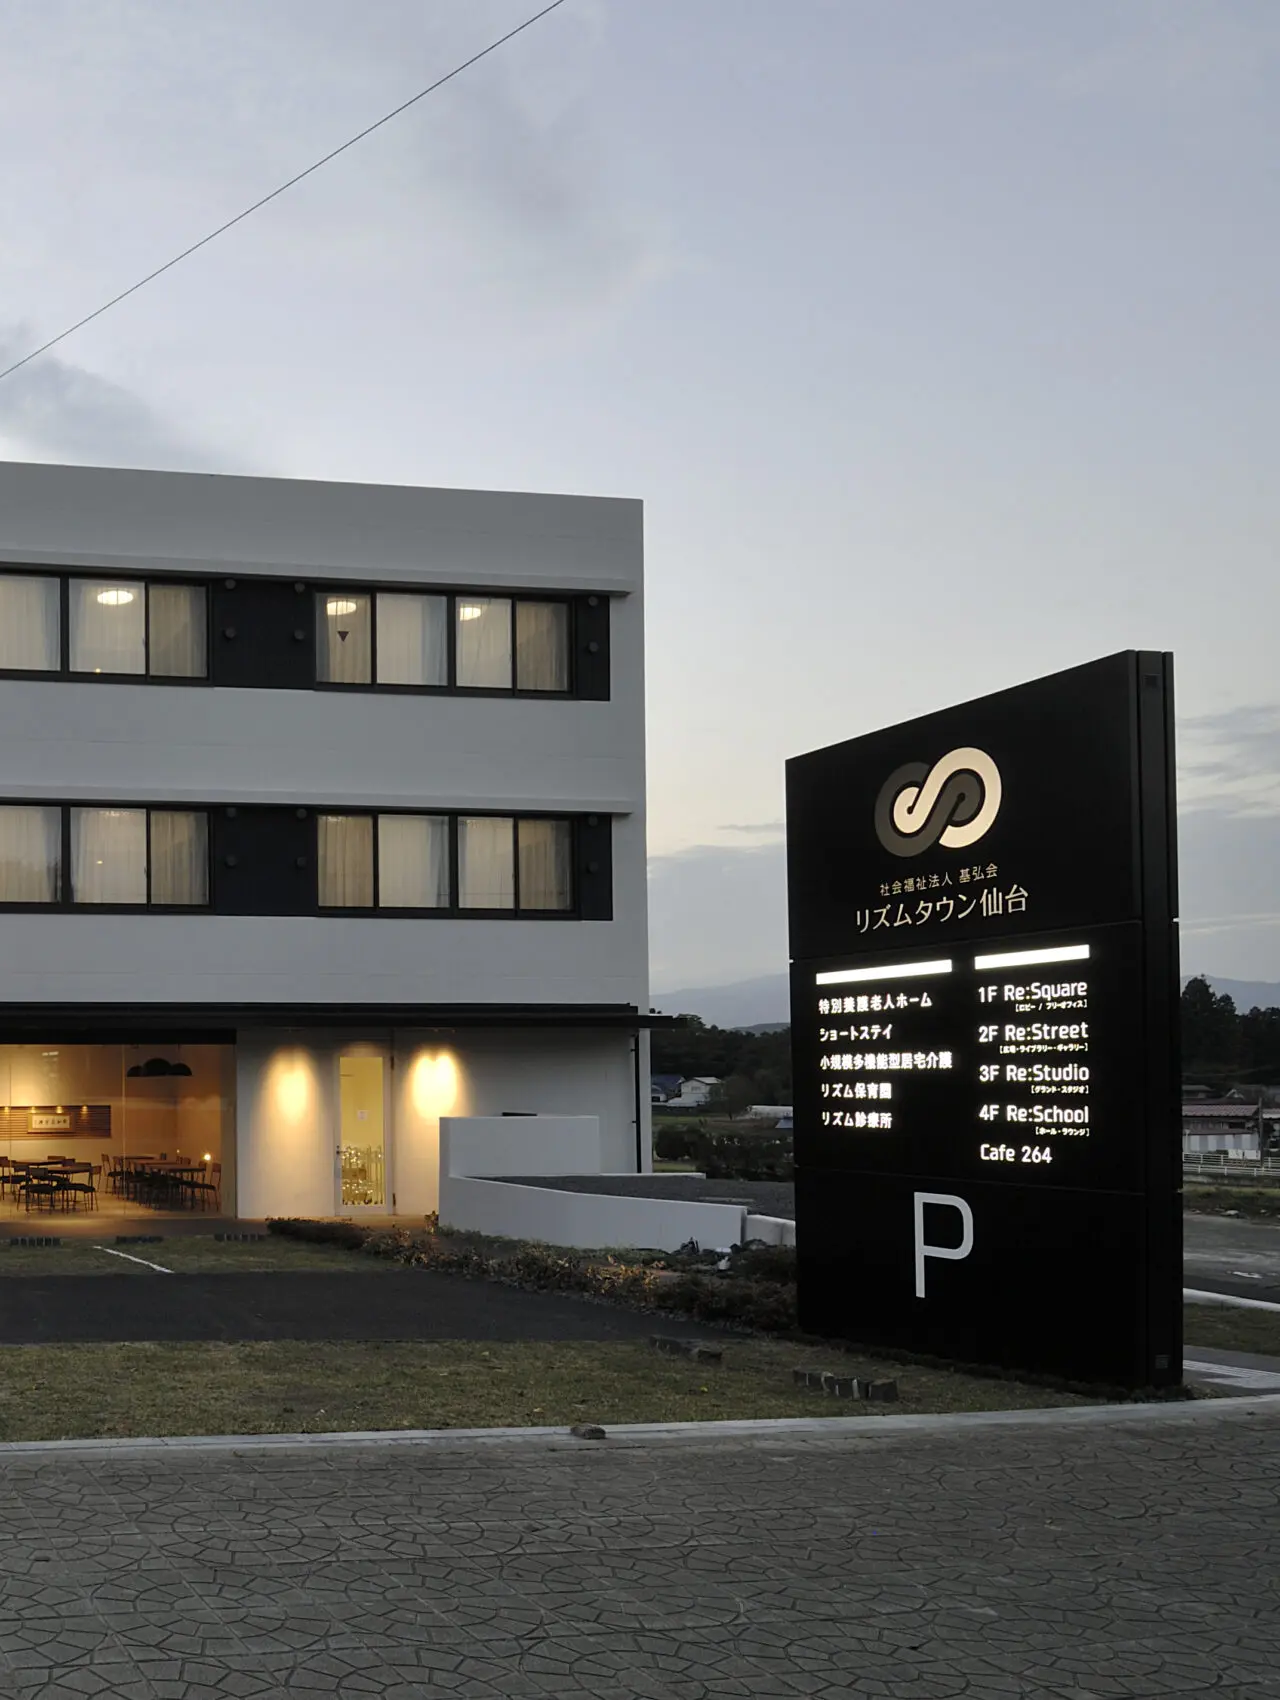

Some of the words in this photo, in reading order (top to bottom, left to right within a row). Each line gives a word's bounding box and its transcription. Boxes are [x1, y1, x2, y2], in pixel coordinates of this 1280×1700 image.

[879, 871, 953, 897] 社会福祉法人
[958, 863, 998, 884] 基弘会
[855, 884, 1029, 933] リズムタウン仙台
[978, 986, 998, 1003] 1F
[1004, 981, 1088, 1001] Re:Square
[818, 992, 933, 1014] 特別養護老人ホーム
[819, 1023, 893, 1042] ショートステイ
[978, 1025, 999, 1043] 2F
[1005, 1021, 1089, 1041] Re:Street
[820, 1051, 953, 1070] 小規模多機能型居宅介護
[979, 1065, 1000, 1082] 3F
[1006, 1063, 1090, 1081] Re:Studio
[820, 1082, 892, 1099] リズム保育園
[821, 1112, 893, 1129] リズム診療所
[979, 1104, 1000, 1121] 4F
[1006, 1105, 1089, 1123] Re:School
[980, 1143, 1015, 1161] Cafe
[1021, 1146, 1052, 1164] 264
[913, 1191, 974, 1298] P
